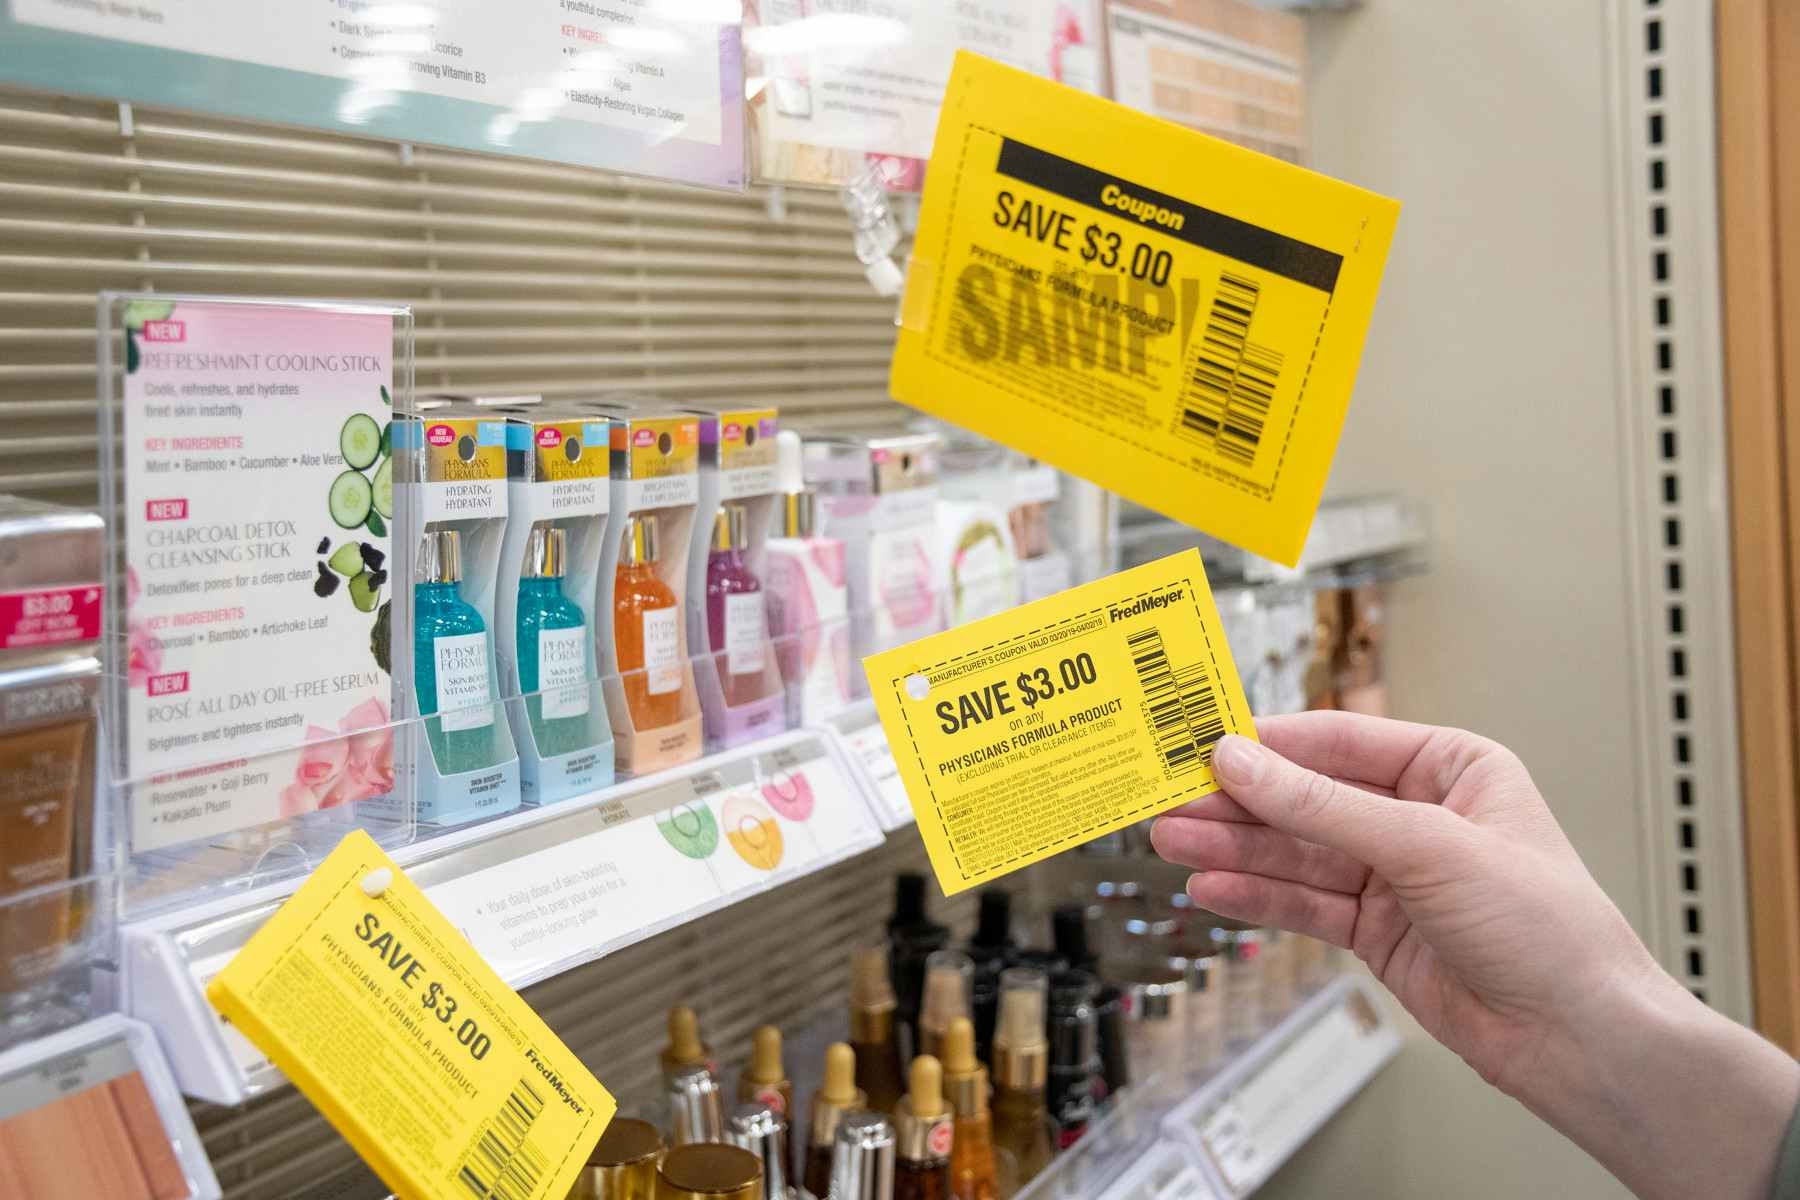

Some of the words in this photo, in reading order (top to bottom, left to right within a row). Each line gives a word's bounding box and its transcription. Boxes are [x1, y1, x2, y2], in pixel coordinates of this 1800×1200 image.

[442, 65, 473, 82] Vitamin
[475, 71, 486, 84] B3
[1100, 183, 1185, 231] Coupon
[993, 190, 1076, 252] SAVE
[1079, 223, 1172, 288] $3.00
[970, 244, 1043, 287] PHYSICIANS
[1047, 274, 1107, 310] FORMULA
[1105, 289, 1175, 335] PRODUCT
[149, 323, 182, 340] NEW
[144, 353, 260, 371] REFRESHMINT
[265, 354, 339, 372] COOLING
[341, 356, 382, 372] STICK
[181, 383, 231, 396] refreshes,
[236, 383, 255, 395] and
[257, 383, 300, 398] hydrates
[174, 404, 197, 417] skin
[199, 403, 243, 418] instantly
[145, 438, 167, 451] KEY
[172, 436, 243, 451] INGREDIENTS
[145, 460, 170, 472] Mint
[184, 459, 227, 472] Bamboo
[239, 456, 289, 469] Cucumber
[301, 454, 321, 466] Aloe
[322, 453, 343, 465] Vera
[445, 469, 491, 480] FORMULA
[446, 484, 492, 496] HYDRATING
[552, 483, 595, 495] HYDRATING
[552, 495, 595, 509] HYDRATANT
[151, 501, 185, 517] NEW
[446, 498, 492, 510] HYDRATANT
[146, 523, 241, 547] CHARCOAL
[245, 520, 296, 539] DETOX
[146, 545, 243, 571] CLEANSING
[246, 540, 291, 559] STICK
[146, 580, 200, 598] Detoxifies
[203, 577, 233, 593] pores
[235, 575, 249, 588] for
[252, 576, 258, 585] a
[260, 571, 285, 586] deep
[287, 568, 312, 582] clean
[146, 615, 170, 629] KEY
[173, 607, 244, 627] INGREDIENTS
[146, 633, 194, 650] Charcoal
[208, 626, 249, 642] Bamboo
[261, 621, 305, 637] Artichoke
[307, 616, 328, 629] Leaf
[928, 652, 995, 685] MANUFACTURER'S
[994, 644, 1027, 662] COUPON
[1027, 635, 1049, 651] VALID
[1049, 617, 1104, 643] 03/20/19-04/02/19
[152, 676, 185, 693] NEW
[199, 697, 223, 716] ALL
[229, 692, 258, 712] DAY
[263, 680, 328, 705] OIL-FREE
[332, 671, 379, 693] SERUM
[936, 680, 1016, 735] SAVE
[1016, 652, 1097, 709] $3.00
[148, 731, 200, 752] Brightens
[202, 729, 220, 741] and
[222, 722, 263, 741] tightens
[264, 713, 304, 732] instantly
[1009, 716, 1024, 732] on
[1025, 709, 1044, 728] any
[939, 743, 1010, 776] PHYSICIANS
[1011, 722, 1068, 754] FORMULA
[1068, 698, 1124, 734] PRODUCT
[956, 759, 1005, 784] (EXCLUDING
[1005, 750, 1029, 768] TRIAL
[1030, 747, 1042, 760] OR
[1042, 727, 1091, 757] CLEARANCE
[1091, 716, 1117, 740] ITEMS)
[152, 785, 208, 805] Rosewater
[220, 776, 239, 791] Goji
[242, 771, 269, 789] Berry
[162, 807, 201, 824] Kakadu
[204, 799, 231, 815] Plum
[487, 897, 506, 915] Your
[508, 889, 529, 911] daily
[530, 884, 551, 901] dose
[552, 878, 562, 893] of
[536, 904, 547, 917] to
[548, 897, 569, 918] prep
[570, 892, 588, 909] your
[589, 886, 605, 902] skin
[607, 880, 618, 894] for
[354, 912, 427, 989] SAVE
[421, 982, 493, 1062] $3.00
[321, 933, 384, 999] PHYSICIANS
[384, 994, 433, 1049] FORMULA
[432, 1043, 480, 1100] PRODUCT
